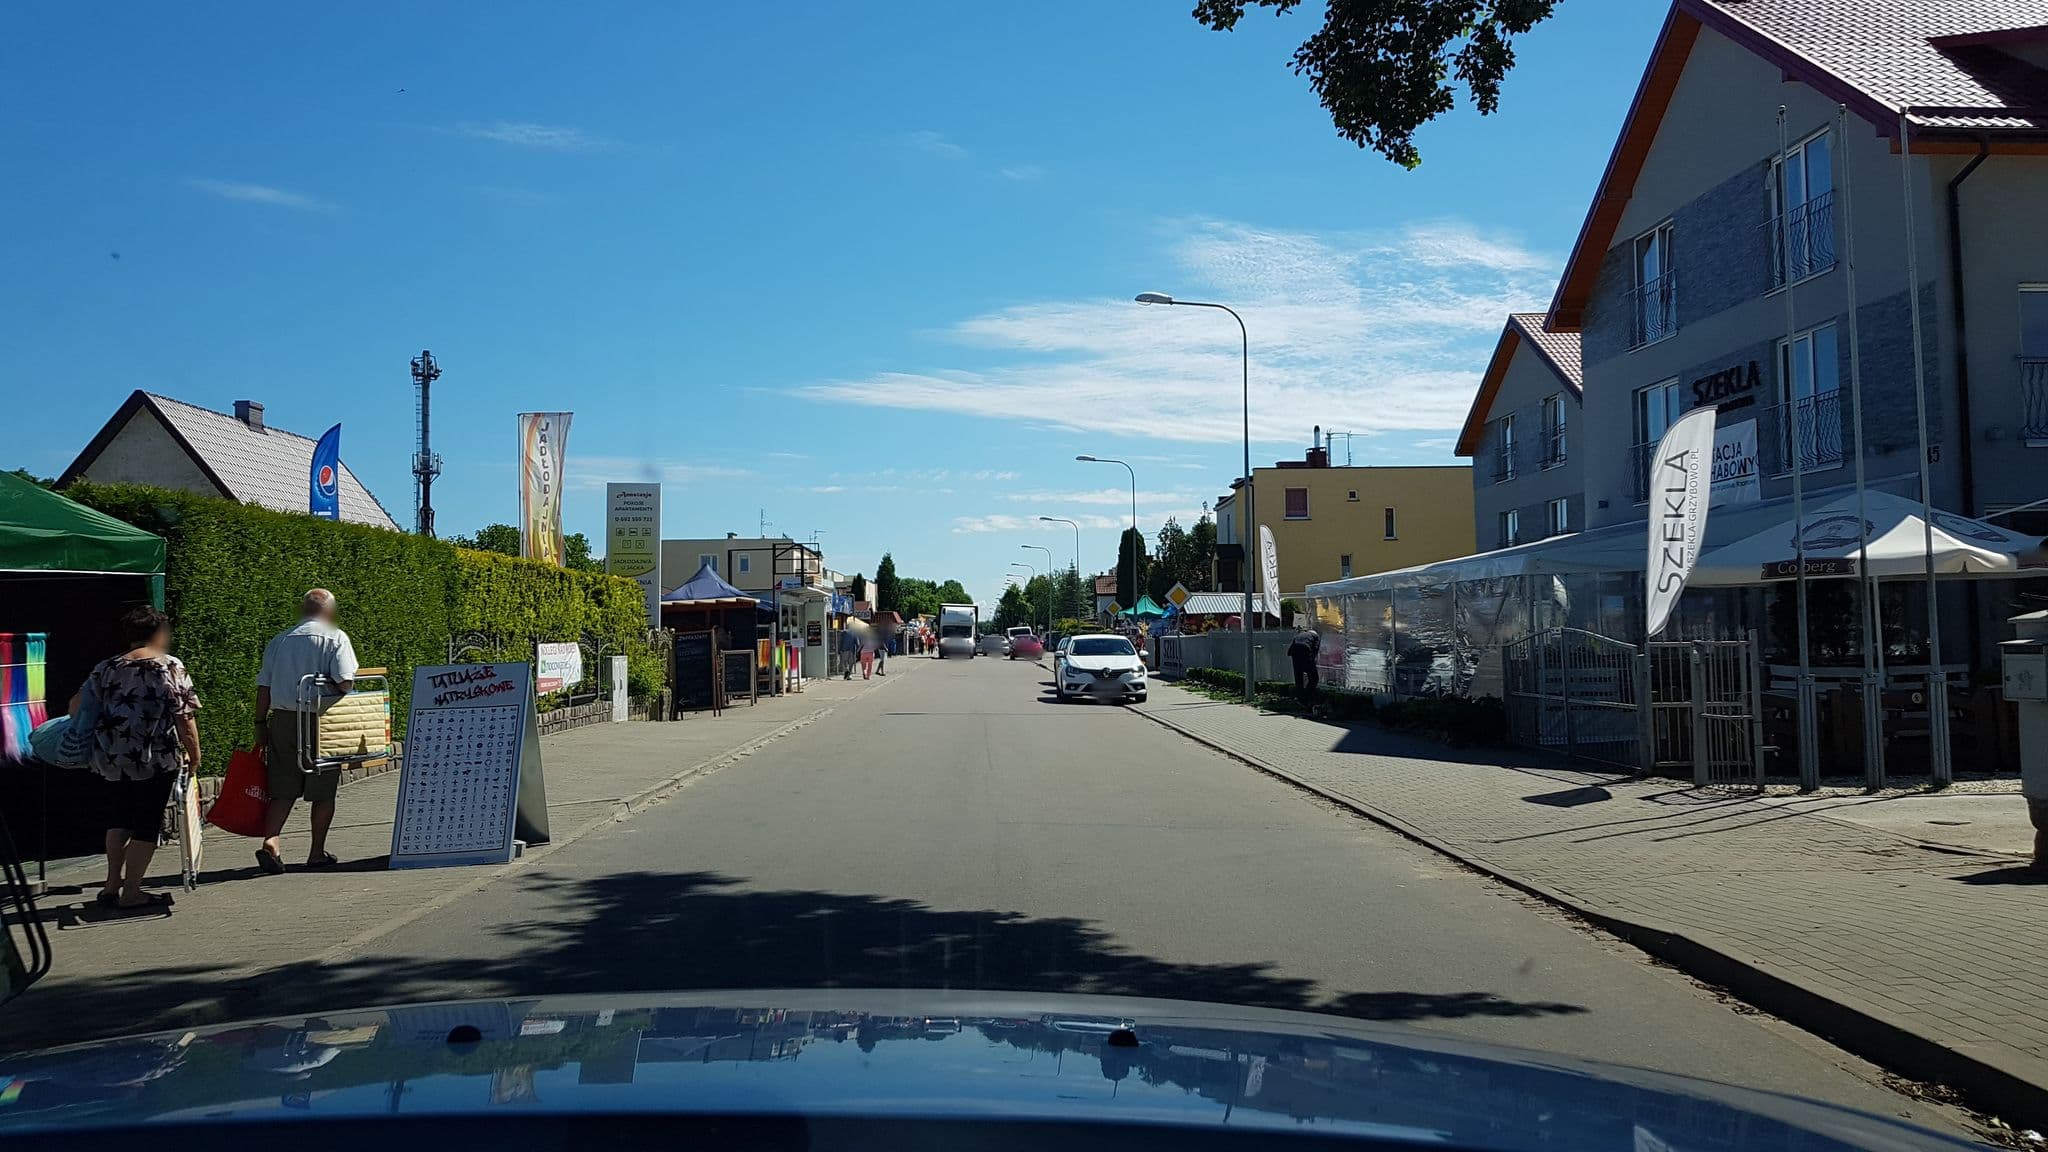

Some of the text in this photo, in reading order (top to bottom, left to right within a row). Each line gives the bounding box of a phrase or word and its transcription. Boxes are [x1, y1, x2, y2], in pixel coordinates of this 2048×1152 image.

[1693, 360, 1760, 401] SZEKLA
[1657, 449, 1689, 594] SZEKLA
[1777, 560, 1836, 574] Coberg
